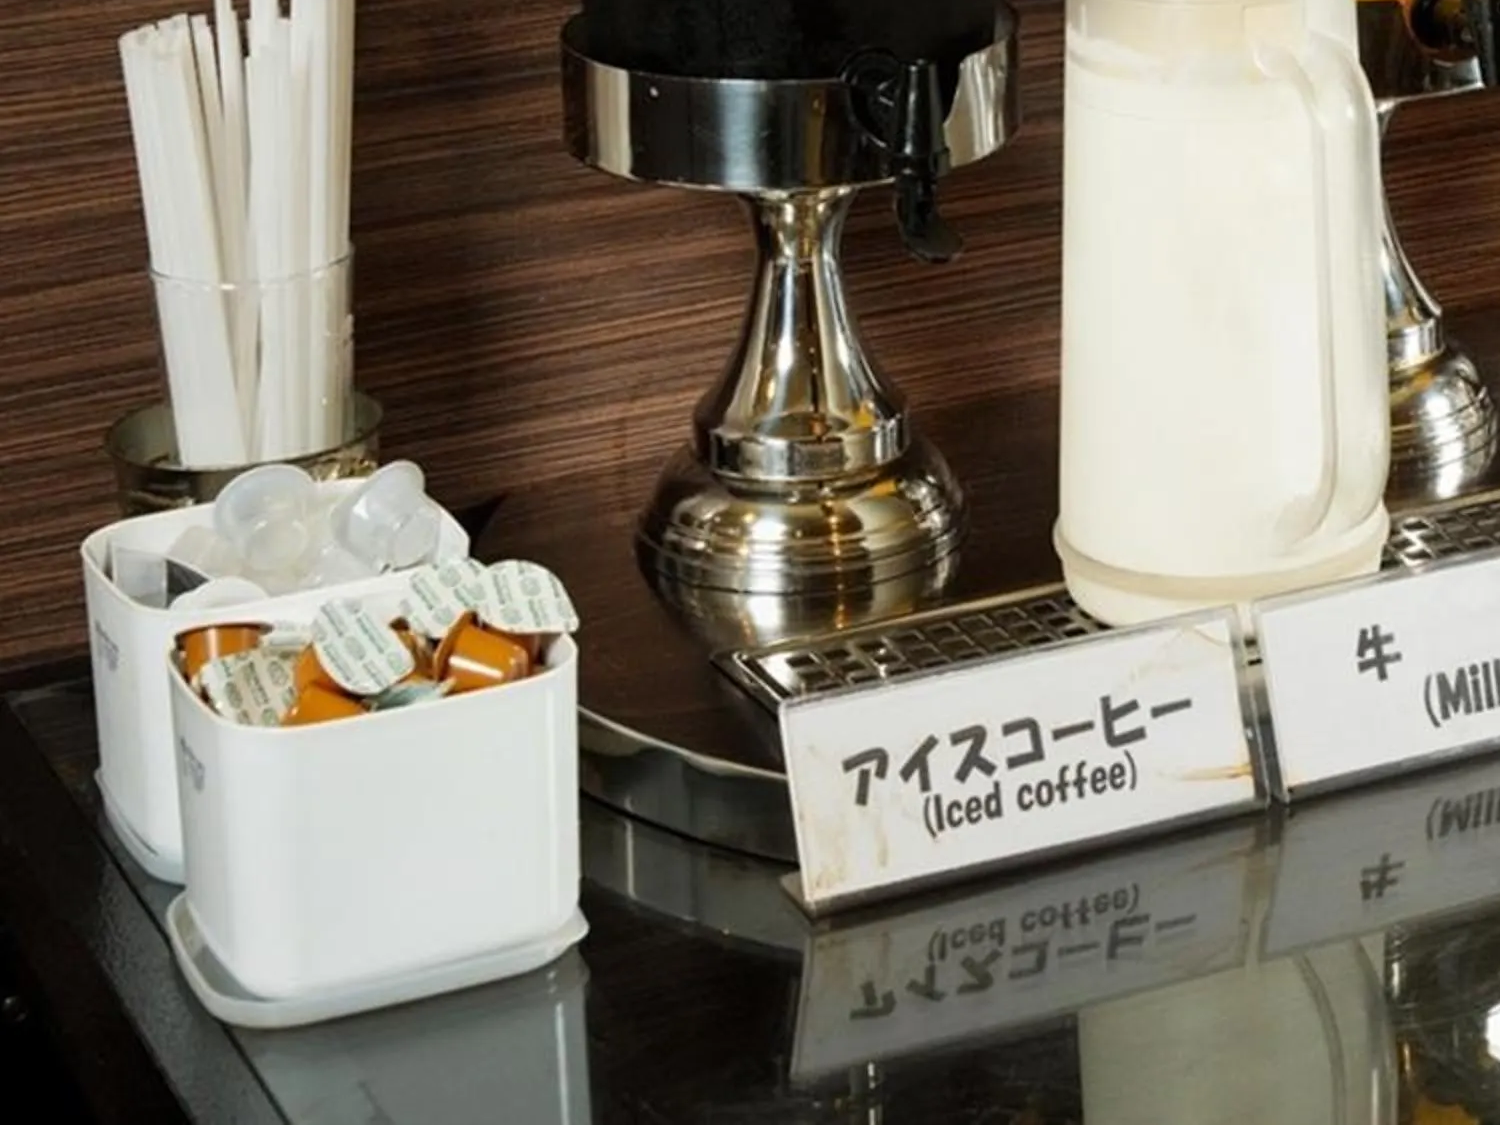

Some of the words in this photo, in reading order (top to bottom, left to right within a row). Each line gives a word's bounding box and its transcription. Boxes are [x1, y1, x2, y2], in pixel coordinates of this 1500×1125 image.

[842, 696, 1192, 806] アイスコーヒー
[923, 781, 1001, 838] (Iced
[1017, 750, 1138, 813] coffee)
